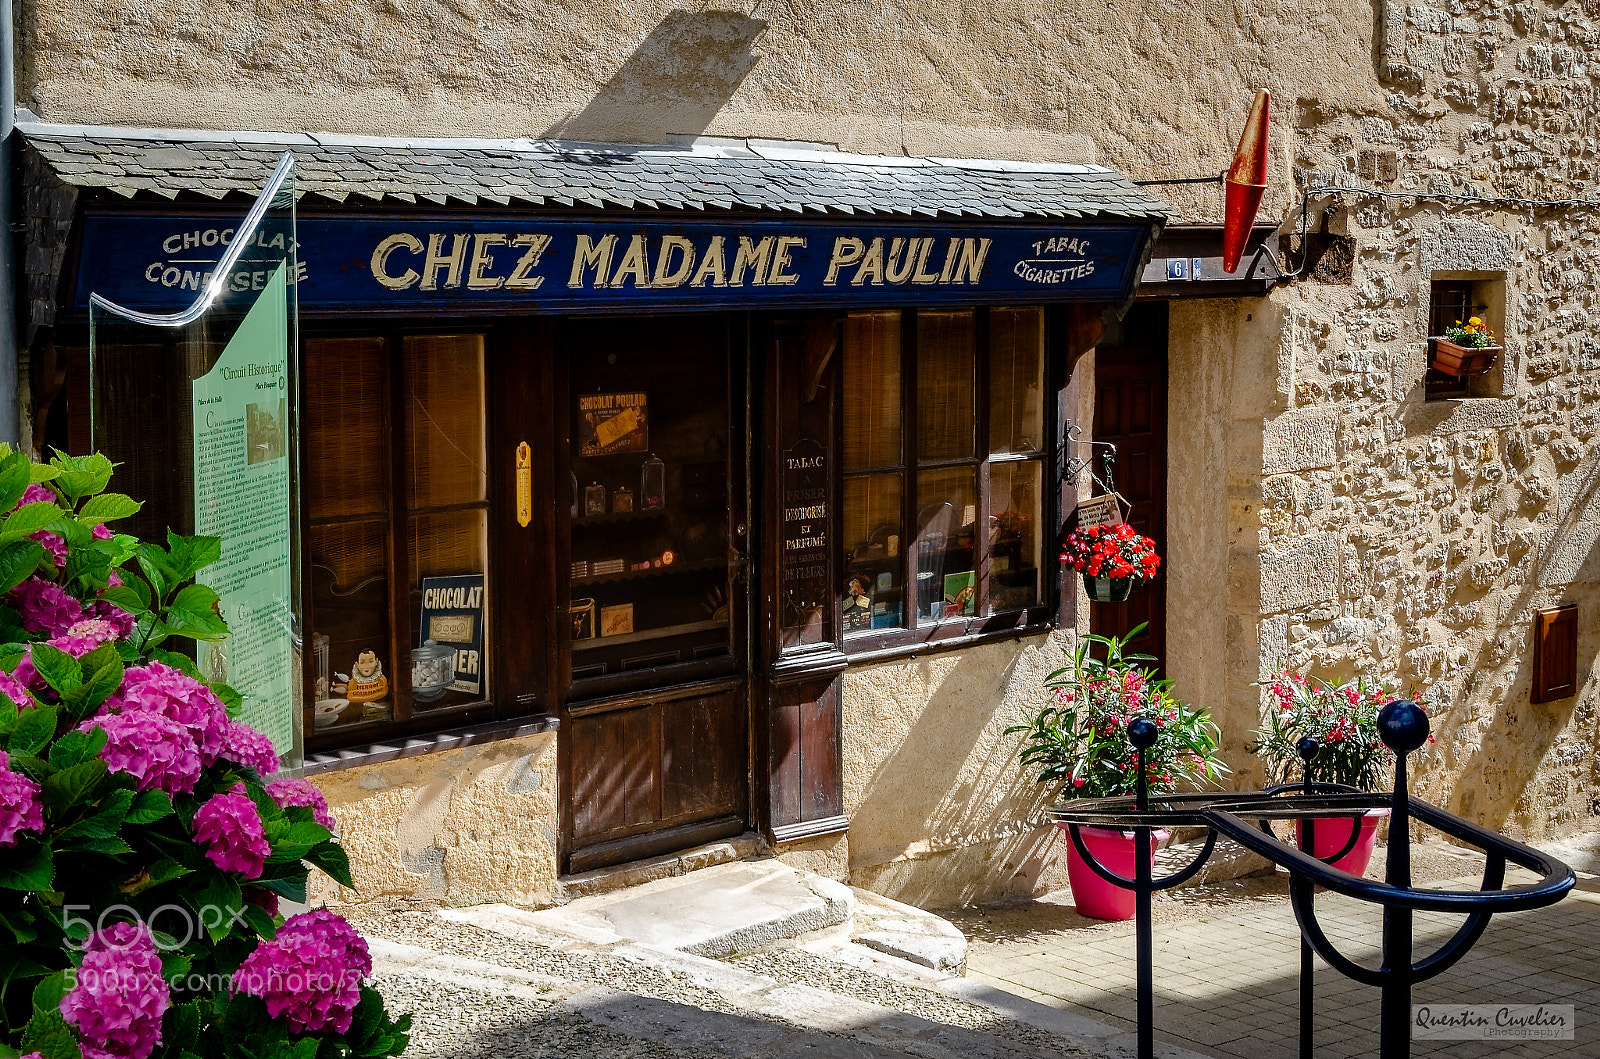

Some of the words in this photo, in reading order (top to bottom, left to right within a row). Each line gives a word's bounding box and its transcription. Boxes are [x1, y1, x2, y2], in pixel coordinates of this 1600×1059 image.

[163, 229, 301, 254] CHOCLAT
[1032, 236, 1090, 256] TABAC
[370, 232, 553, 291] CHEZ
[567, 233, 807, 289] MADAME
[823, 236, 993, 287] PAULIN
[1013, 260, 1095, 284] CIGARETTES
[1174, 262, 1182, 277] 6
[579, 395, 614, 411] CHOCOLAT
[615, 393, 647, 408] POULAIN
[786, 455, 824, 469] TABAC
[424, 586, 483, 610] CHOCOLAT
